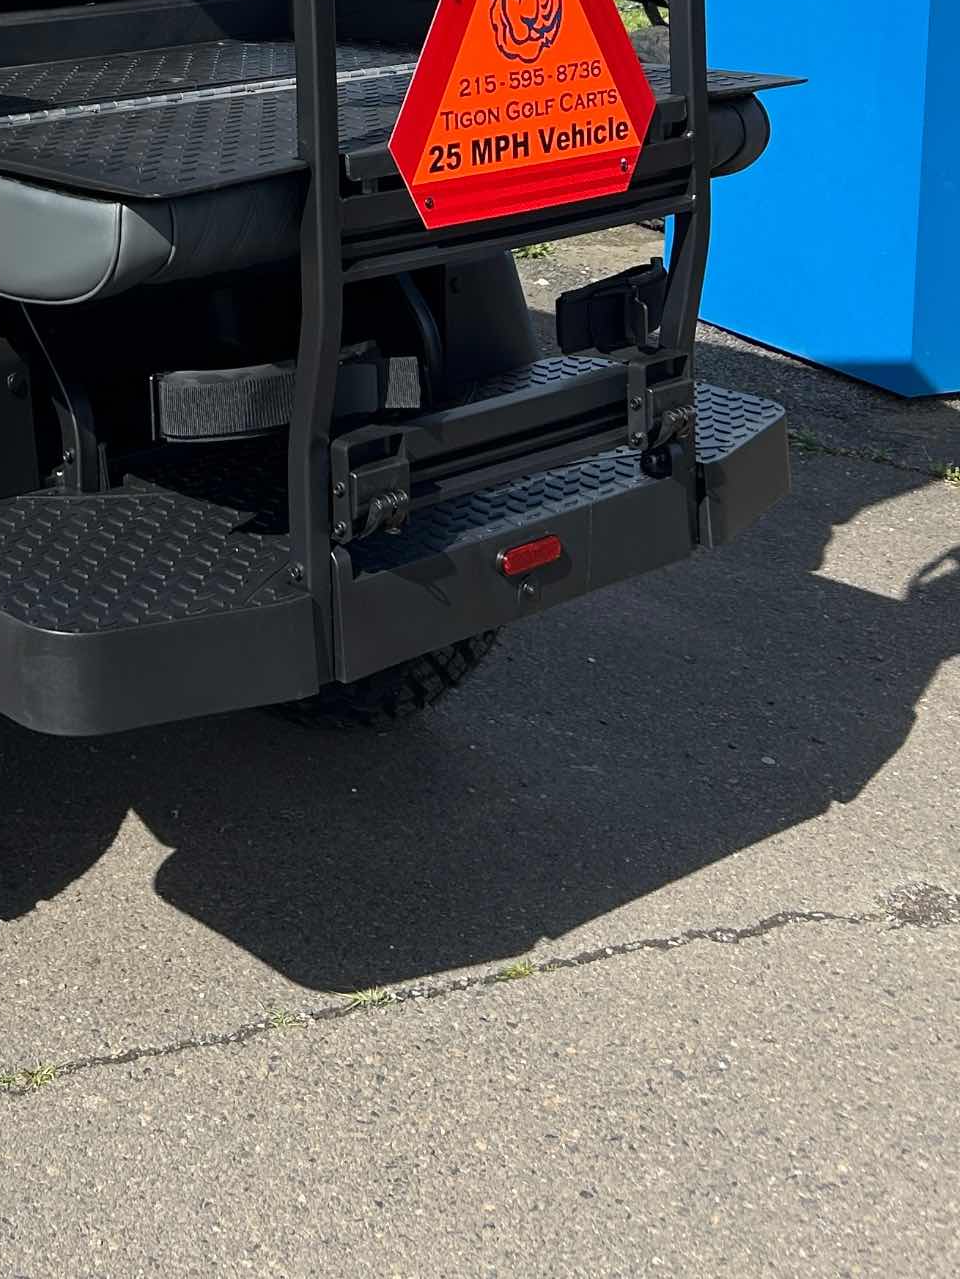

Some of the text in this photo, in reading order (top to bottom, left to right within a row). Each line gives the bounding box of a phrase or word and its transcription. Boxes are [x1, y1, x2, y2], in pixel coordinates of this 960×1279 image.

[459, 59, 602, 97] 215-595-8736
[440, 88, 618, 131] TIGON GOLF CARTS
[429, 117, 629, 173] 25 MPH Vehicle
